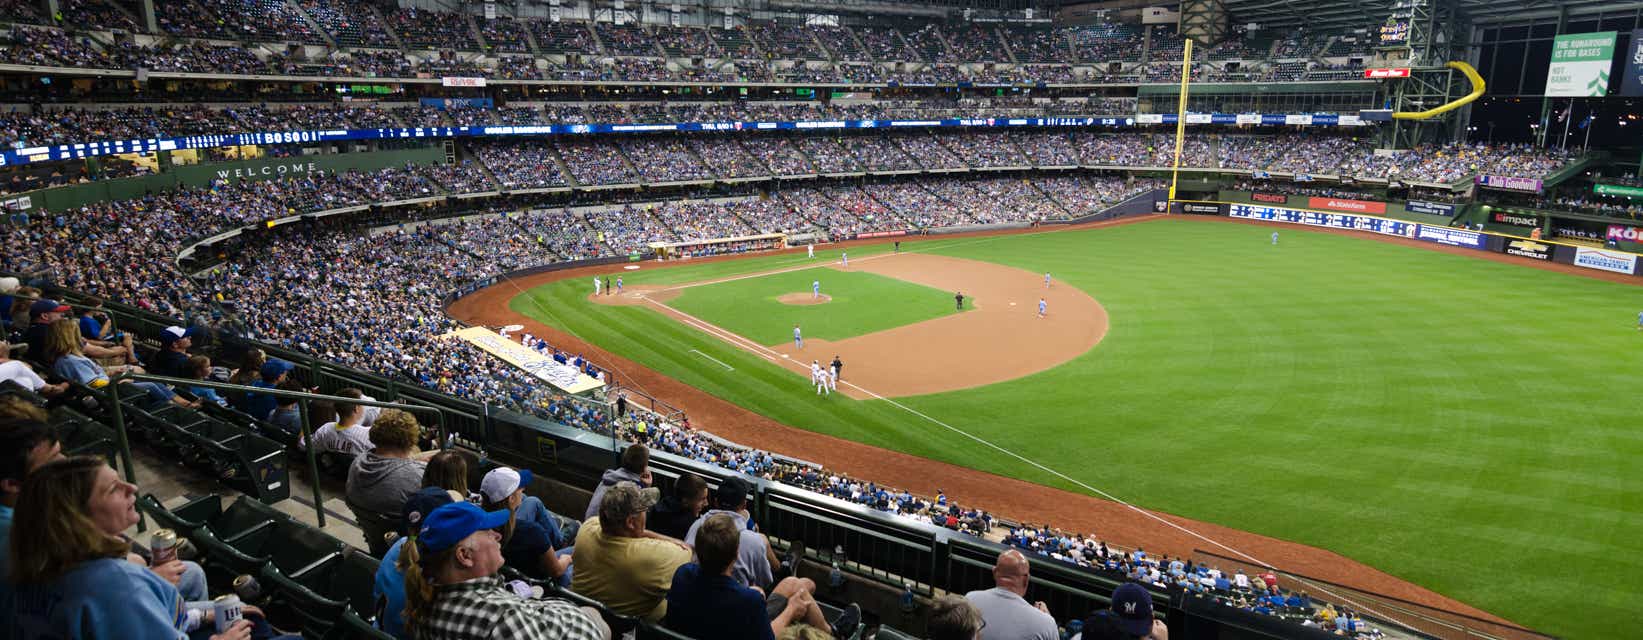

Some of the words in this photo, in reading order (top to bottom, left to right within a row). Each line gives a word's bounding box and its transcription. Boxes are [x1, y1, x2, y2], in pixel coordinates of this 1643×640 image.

[1557, 40, 1568, 49] THE
[1570, 38, 1612, 48] RUNAROUND
[1555, 50, 1562, 58] IS
[1563, 49, 1577, 57] FOR
[1578, 48, 1601, 57] BASES
[217, 162, 316, 178] WELCOME
[1489, 176, 1504, 187] Club
[1504, 177, 1537, 191] Goodwill
[1502, 214, 1538, 226] impact
[1507, 248, 1548, 259] CHEVROLET
[1579, 255, 1608, 263] AMERICAN
